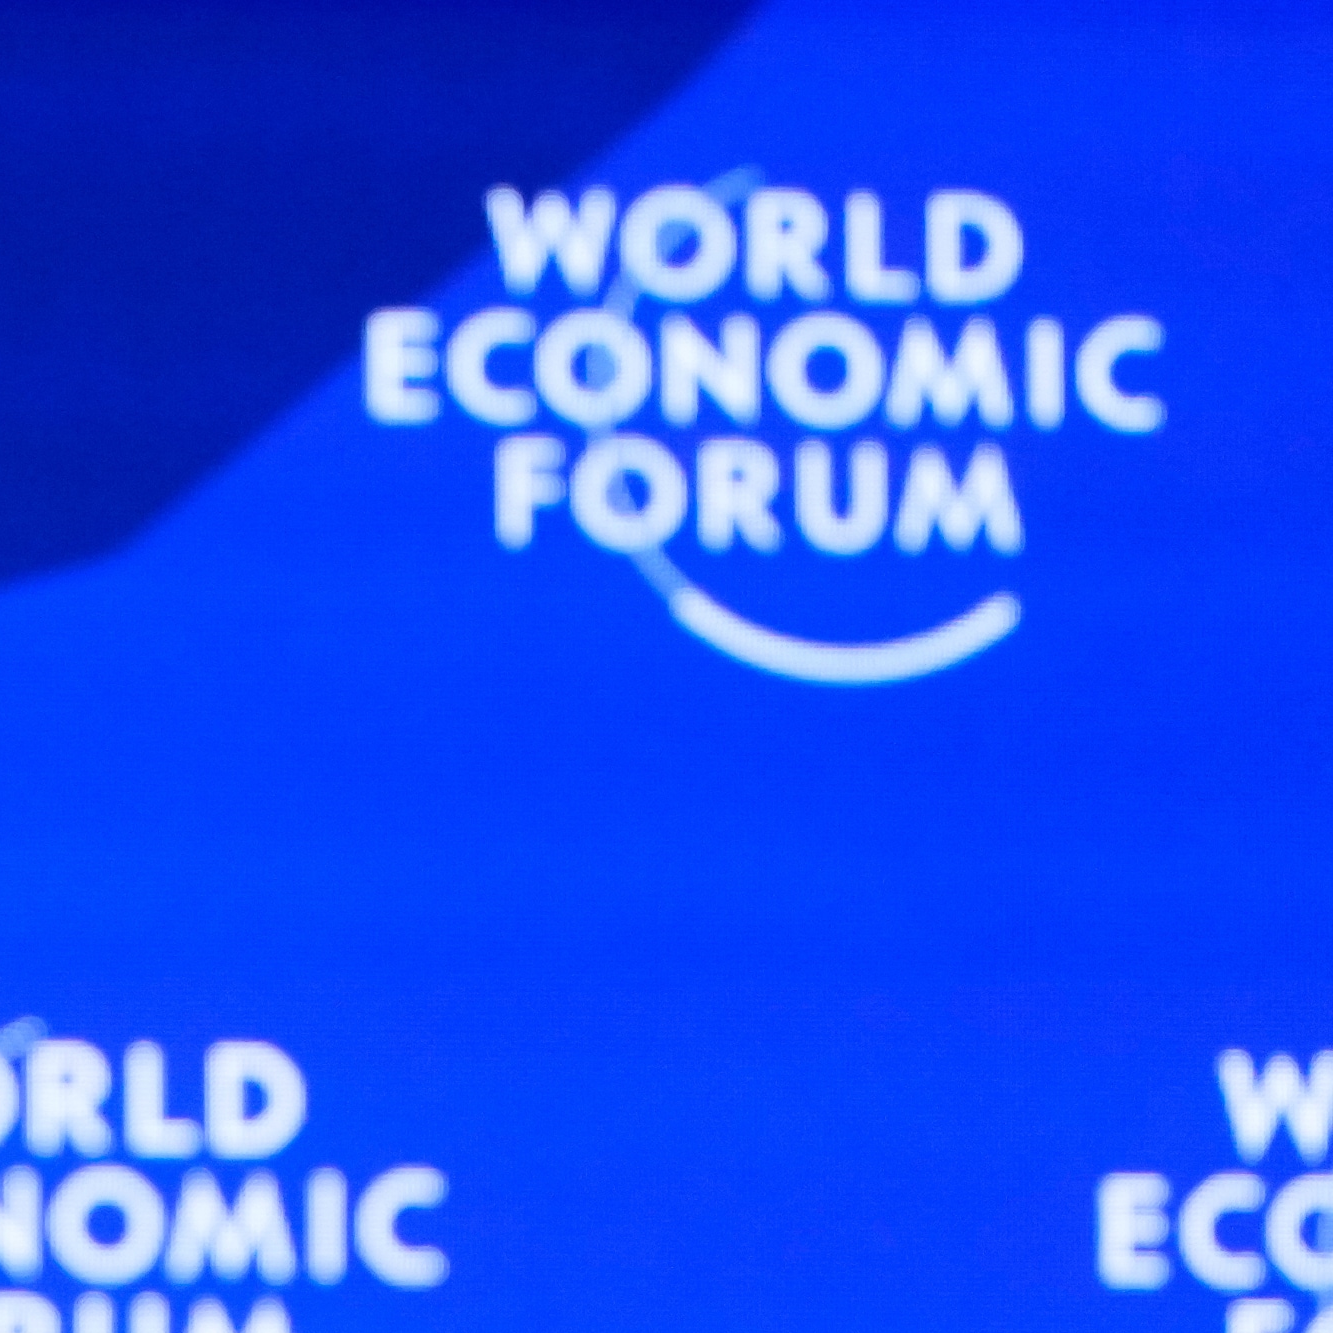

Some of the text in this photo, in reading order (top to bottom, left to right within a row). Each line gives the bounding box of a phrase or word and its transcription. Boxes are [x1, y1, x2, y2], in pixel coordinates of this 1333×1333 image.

[486, 184, 1024, 304] WORLD
[364, 307, 1165, 432] ECONOMIC
[494, 434, 1024, 555] FORUM
